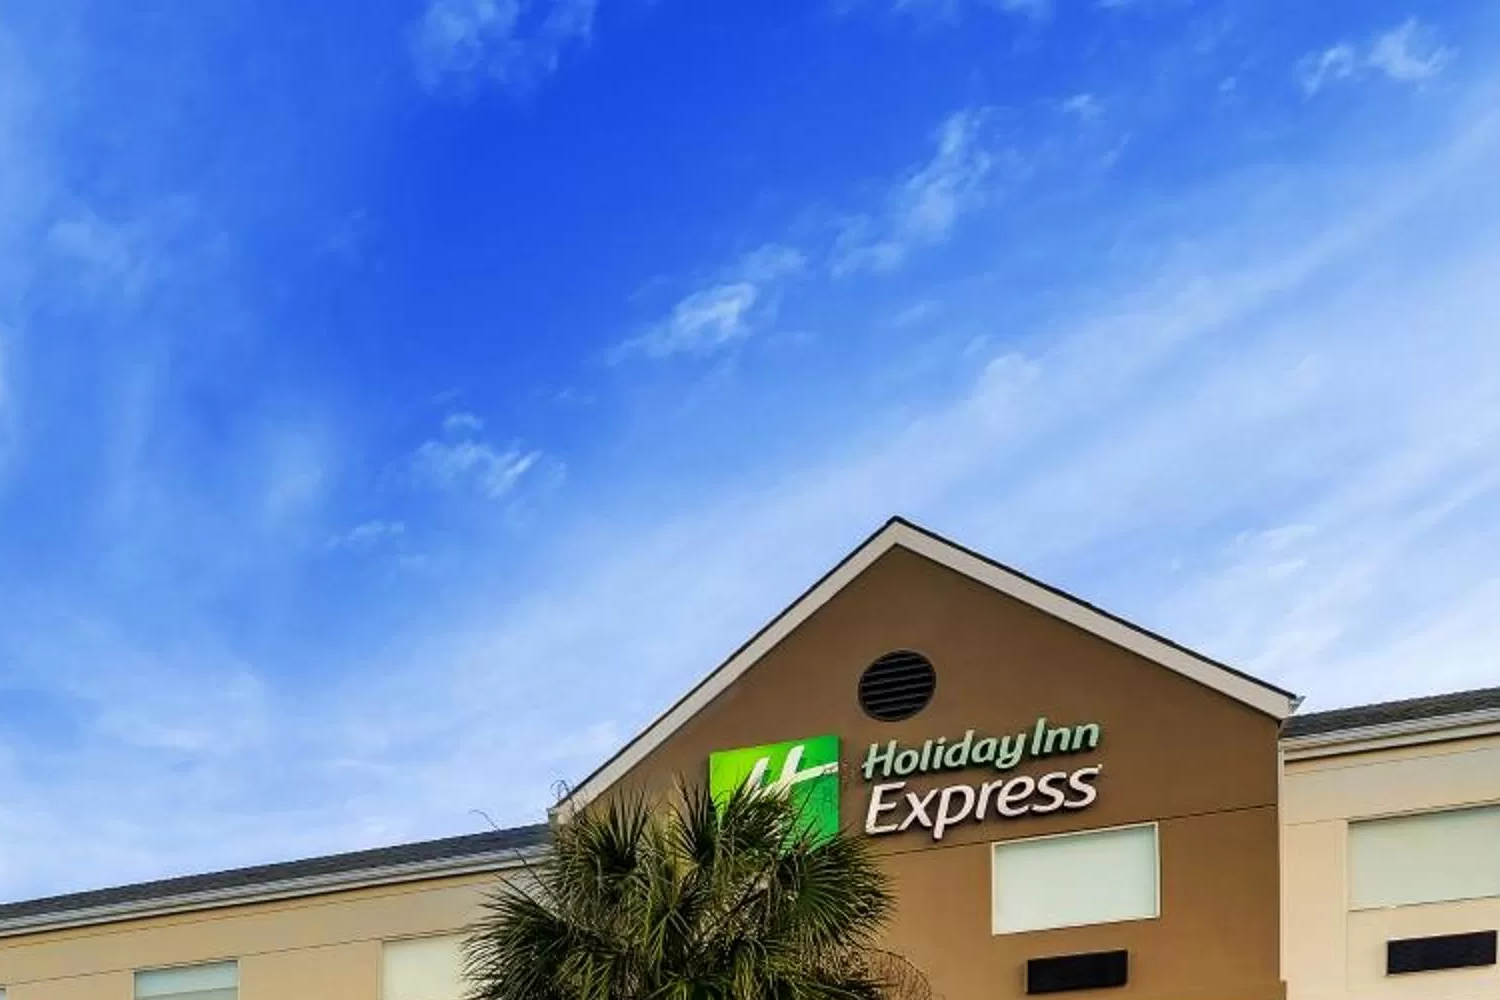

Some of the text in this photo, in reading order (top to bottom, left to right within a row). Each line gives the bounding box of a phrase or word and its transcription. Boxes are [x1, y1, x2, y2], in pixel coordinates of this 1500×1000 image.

[863, 718, 1100, 778] Holiday Inn
[866, 765, 1100, 839] Express
